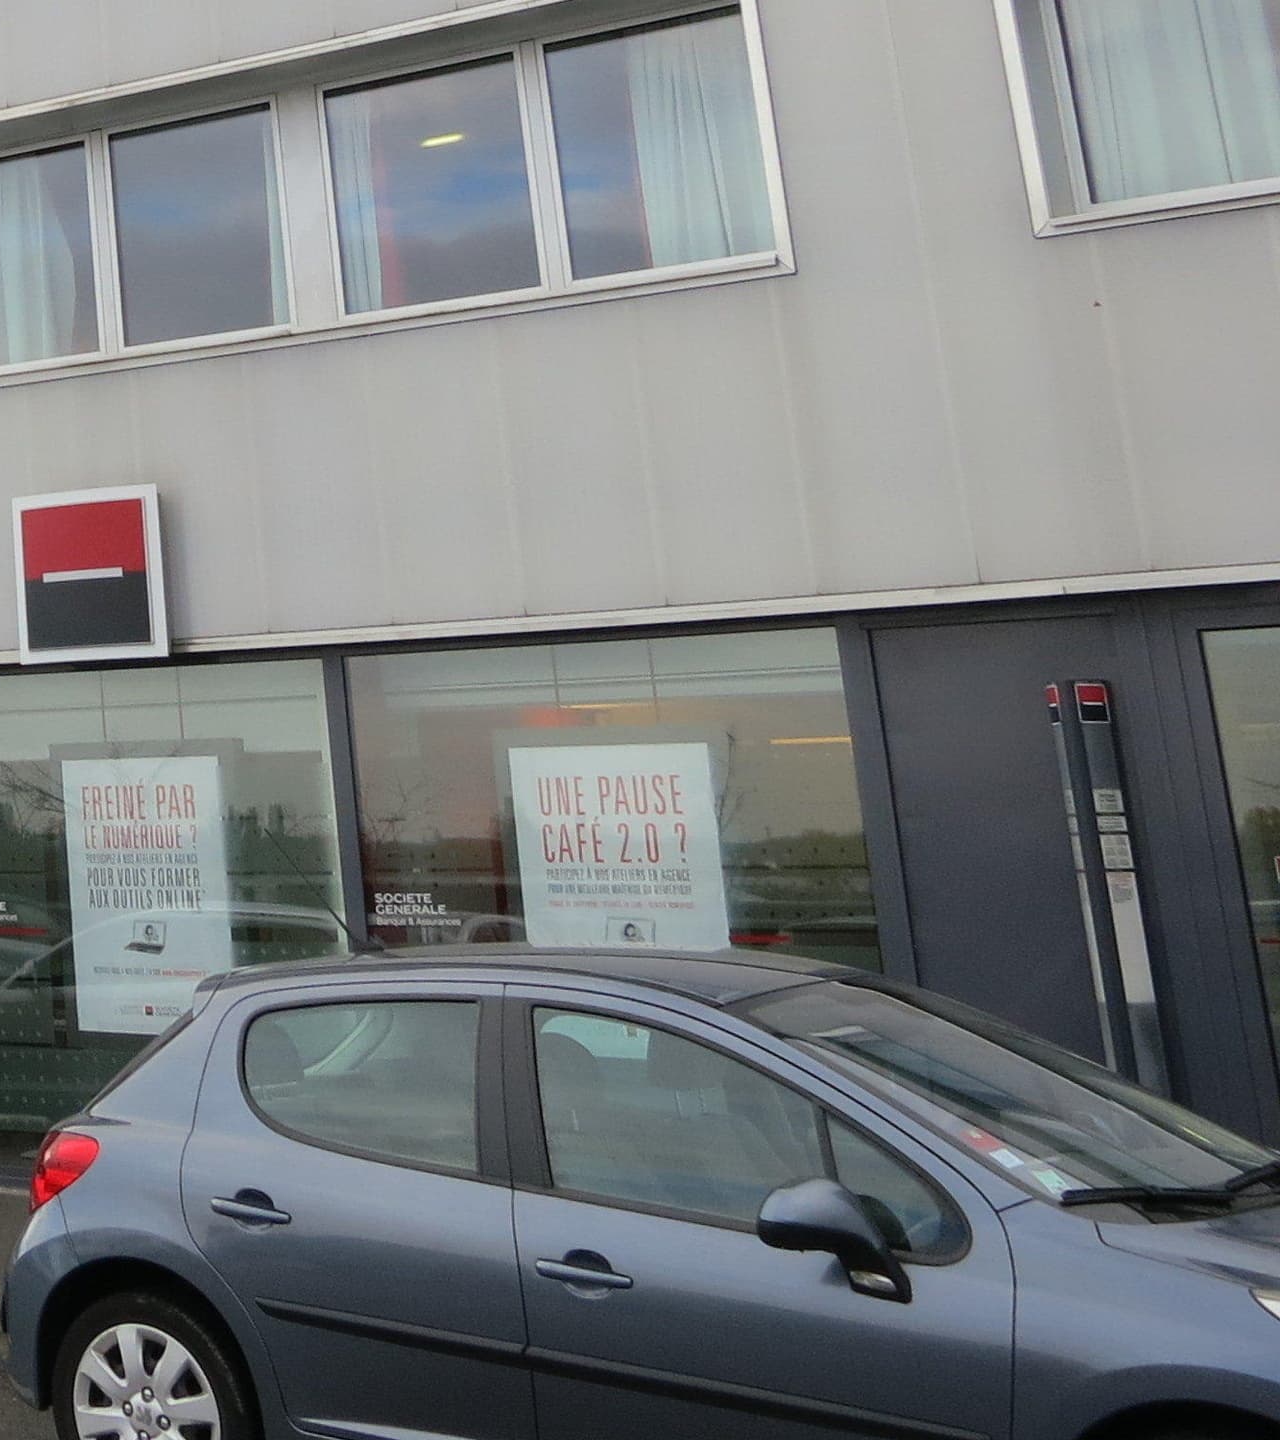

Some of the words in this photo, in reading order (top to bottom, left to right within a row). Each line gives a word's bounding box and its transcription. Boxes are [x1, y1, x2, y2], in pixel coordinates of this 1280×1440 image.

[81, 777, 147, 821] FREINÉ
[155, 784, 196, 820] PAR
[538, 776, 586, 816] UNE
[597, 774, 684, 816] PAUSE
[84, 824, 97, 849] LE
[103, 820, 183, 849] NUMÉRIQUE
[189, 824, 197, 849] ?
[542, 816, 605, 863] CAFÉ
[617, 822, 660, 863] 2.0
[673, 822, 688, 863] ?
[87, 867, 114, 888] POUR
[116, 867, 146, 887] VOUS
[151, 867, 201, 888] FORMER
[89, 889, 110, 909] AUX
[113, 889, 153, 909] OUTILS
[374, 892, 432, 904] SOCIETE
[375, 904, 446, 915] GENERALE
